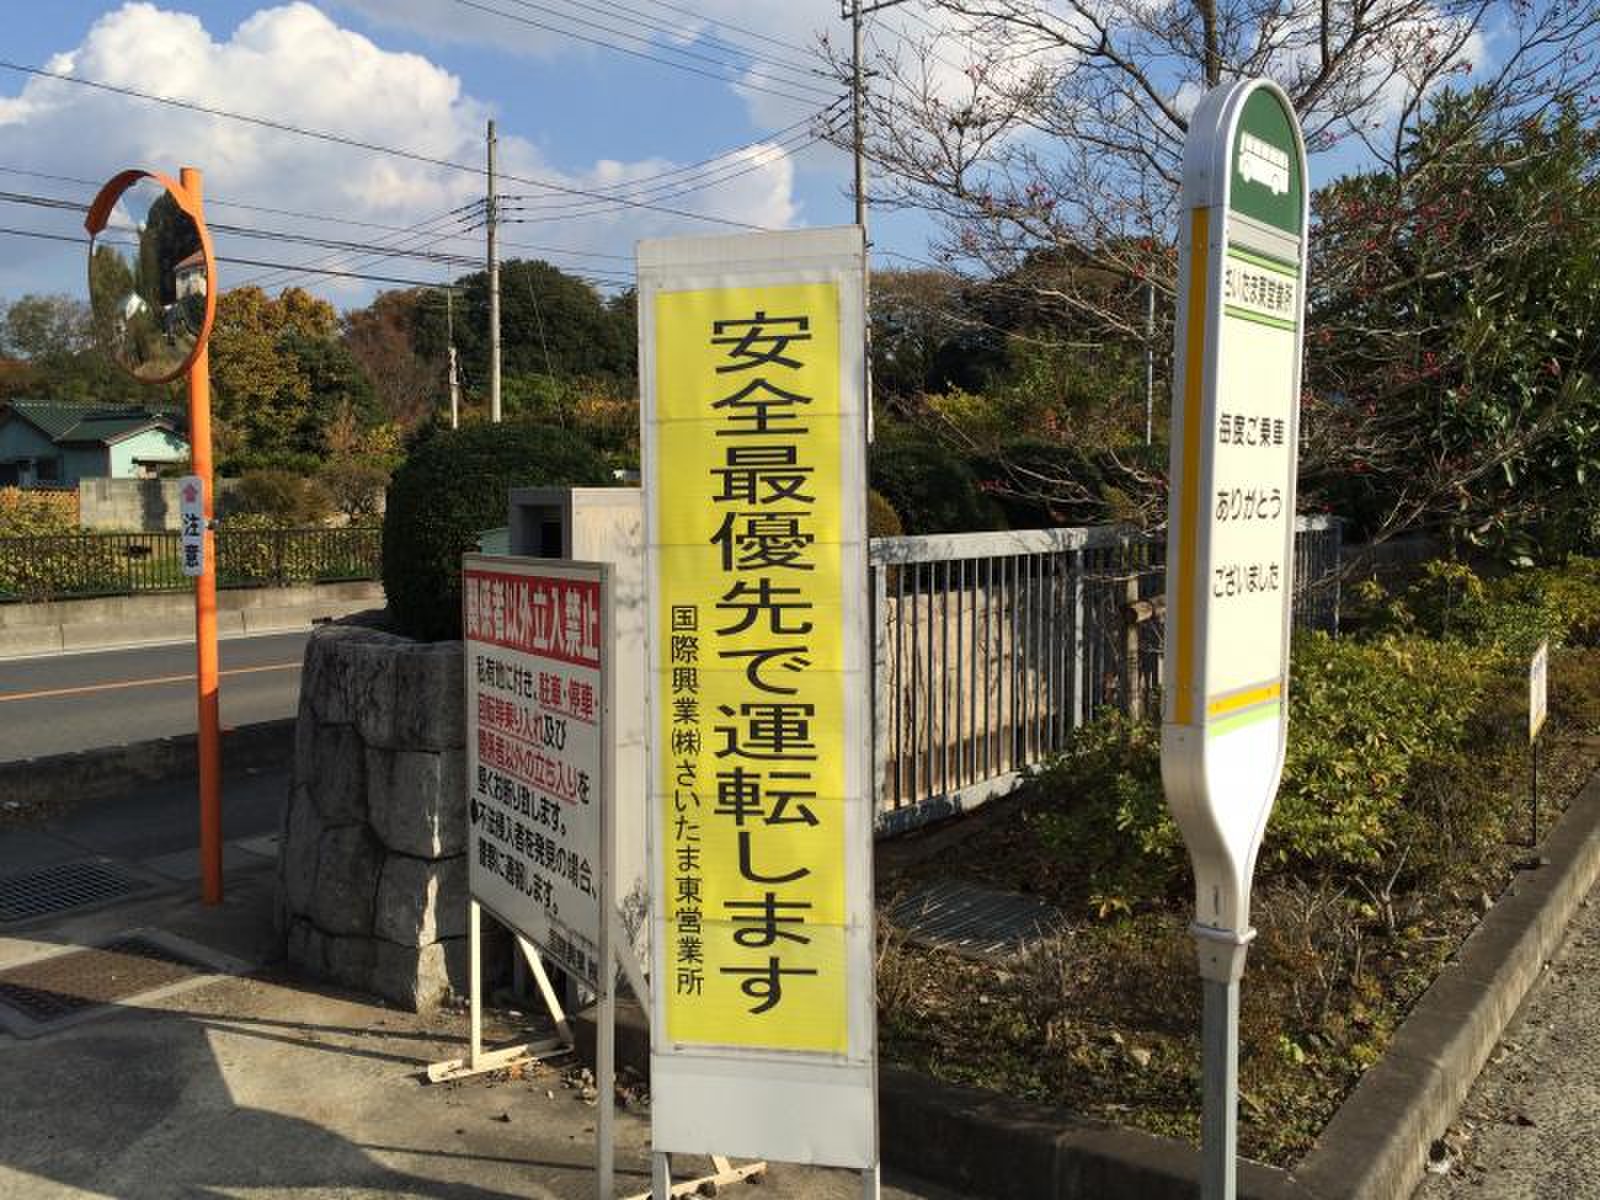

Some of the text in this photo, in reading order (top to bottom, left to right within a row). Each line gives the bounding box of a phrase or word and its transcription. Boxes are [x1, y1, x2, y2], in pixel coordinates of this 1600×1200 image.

[1219, 412, 1284, 447] 毎度ご乗車
[1216, 487, 1281, 522] ありがとう
[183, 512, 200, 568] 注意
[1213, 562, 1279, 598] ございました
[464, 578, 598, 660] 関係者以外立入禁止
[709, 311, 820, 1014] 安全最優先で運転します
